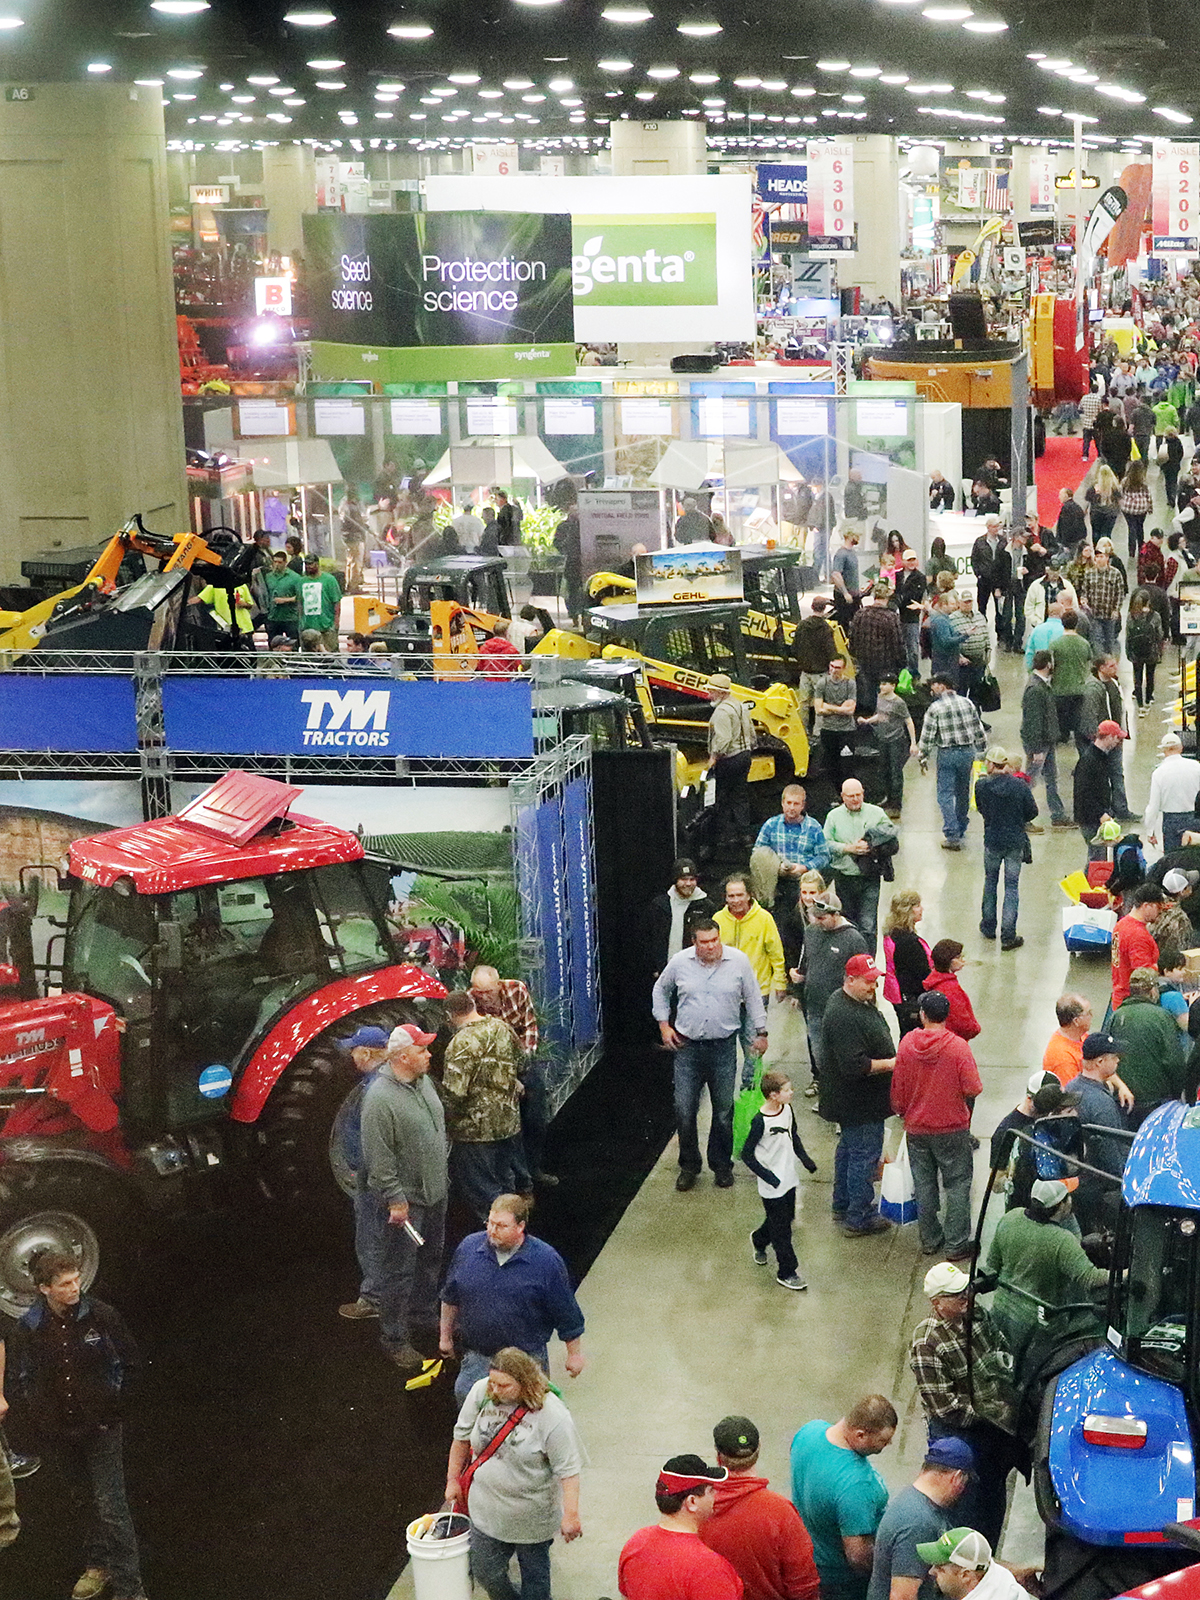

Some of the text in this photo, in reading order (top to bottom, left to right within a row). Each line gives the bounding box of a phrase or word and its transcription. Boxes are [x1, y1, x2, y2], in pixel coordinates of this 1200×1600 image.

[12, 89, 28, 100] A6
[490, 149, 516, 157] AISLE
[824, 147, 850, 155] AISLE
[1171, 147, 1198, 155] AISLE
[498, 162, 509, 175] 6
[195, 188, 223, 197] WHITE
[833, 160, 843, 232] 6300
[1179, 160, 1189, 232] 6200
[341, 255, 371, 281] Seed
[423, 255, 546, 281] Protection
[265, 285, 283, 305] B
[332, 288, 372, 311] science
[423, 285, 518, 311] science
[514, 349, 551, 361] syngenta
[673, 592, 706, 600] GEHL
[590, 616, 609, 630] GEHL
[674, 670, 709, 691] GEH
[301, 690, 390, 730] TYM
[302, 731, 390, 746] TRACTORS
[16, 1027, 45, 1046] TYM
